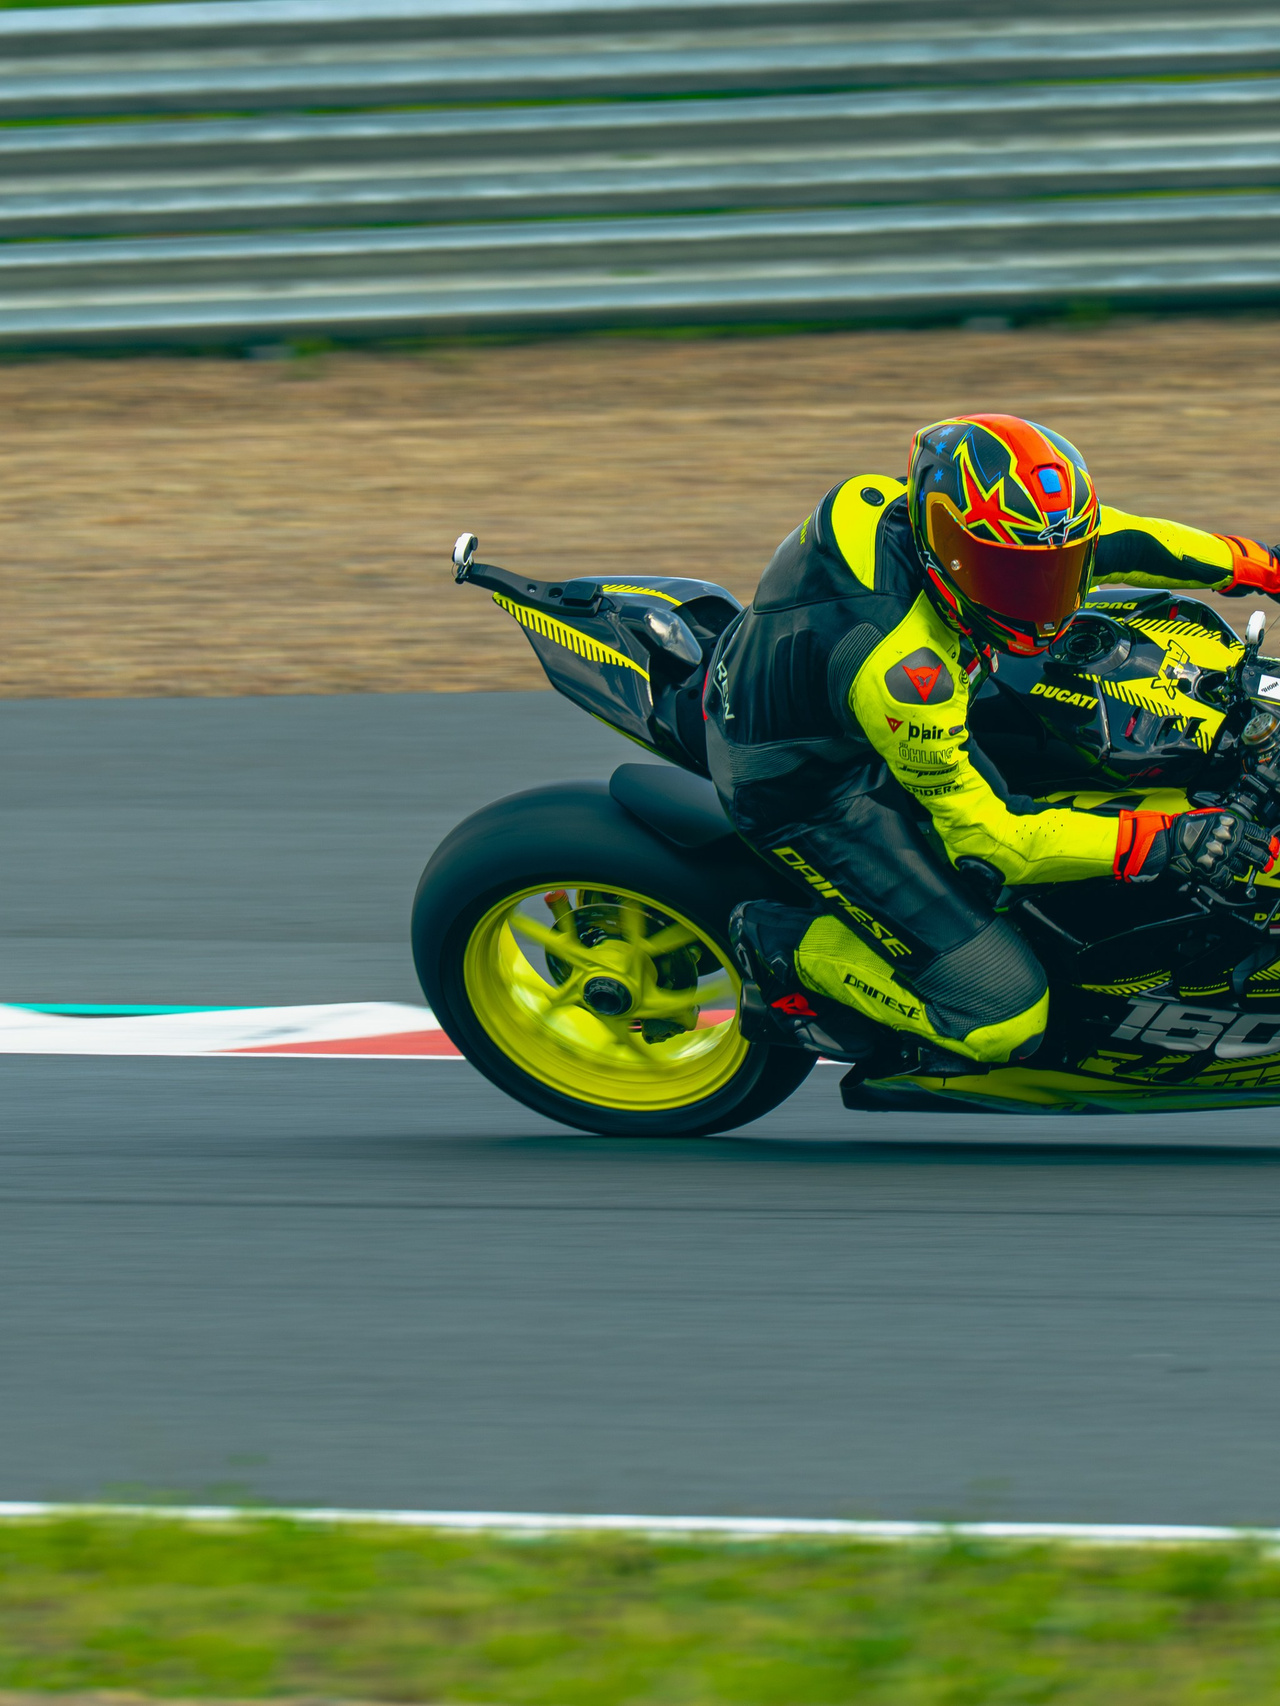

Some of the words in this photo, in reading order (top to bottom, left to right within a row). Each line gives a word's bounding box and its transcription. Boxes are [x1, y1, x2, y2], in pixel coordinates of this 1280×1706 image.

[1079, 602, 1138, 610] DUCA
[1029, 682, 1099, 710] DUCATI
[772, 846, 912, 957] DAINESE
[843, 973, 921, 1021] DAINESE
